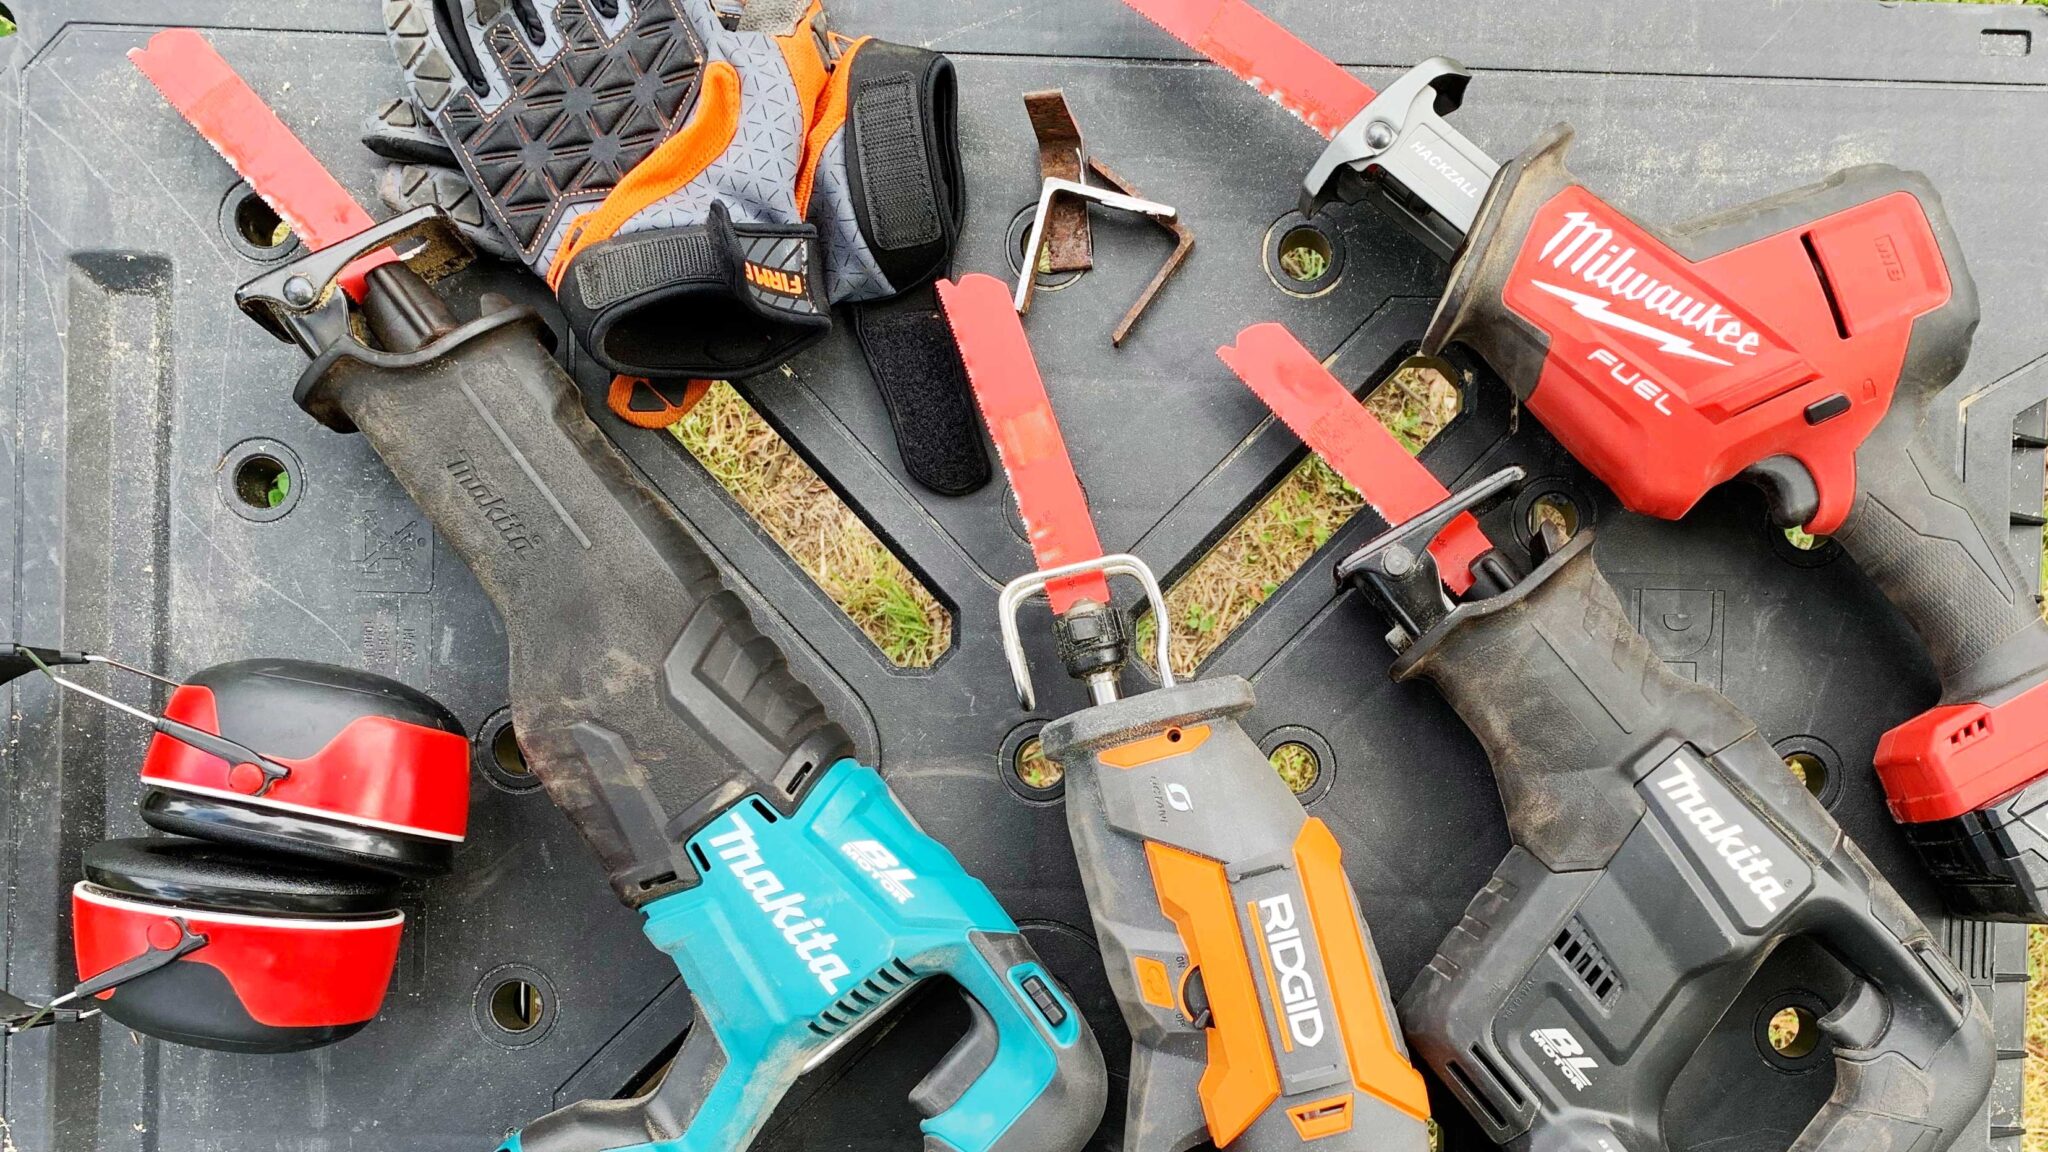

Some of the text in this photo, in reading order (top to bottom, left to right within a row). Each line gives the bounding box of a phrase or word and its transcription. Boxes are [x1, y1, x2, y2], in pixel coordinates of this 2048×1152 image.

[1409, 141, 1478, 198] HACKZALL
[1538, 212, 1760, 356] Milwaukee
[1586, 348, 1673, 417] FUEL
[446, 449, 534, 561] makita
[841, 839, 918, 899] BL
[1657, 757, 1786, 913] makita
[709, 811, 851, 996] makita
[840, 842, 908, 905] MOTOR
[1258, 893, 1324, 1048] RIDGID
[1529, 1030, 1585, 1092] MOTOR
[1535, 1028, 1599, 1086] BL
